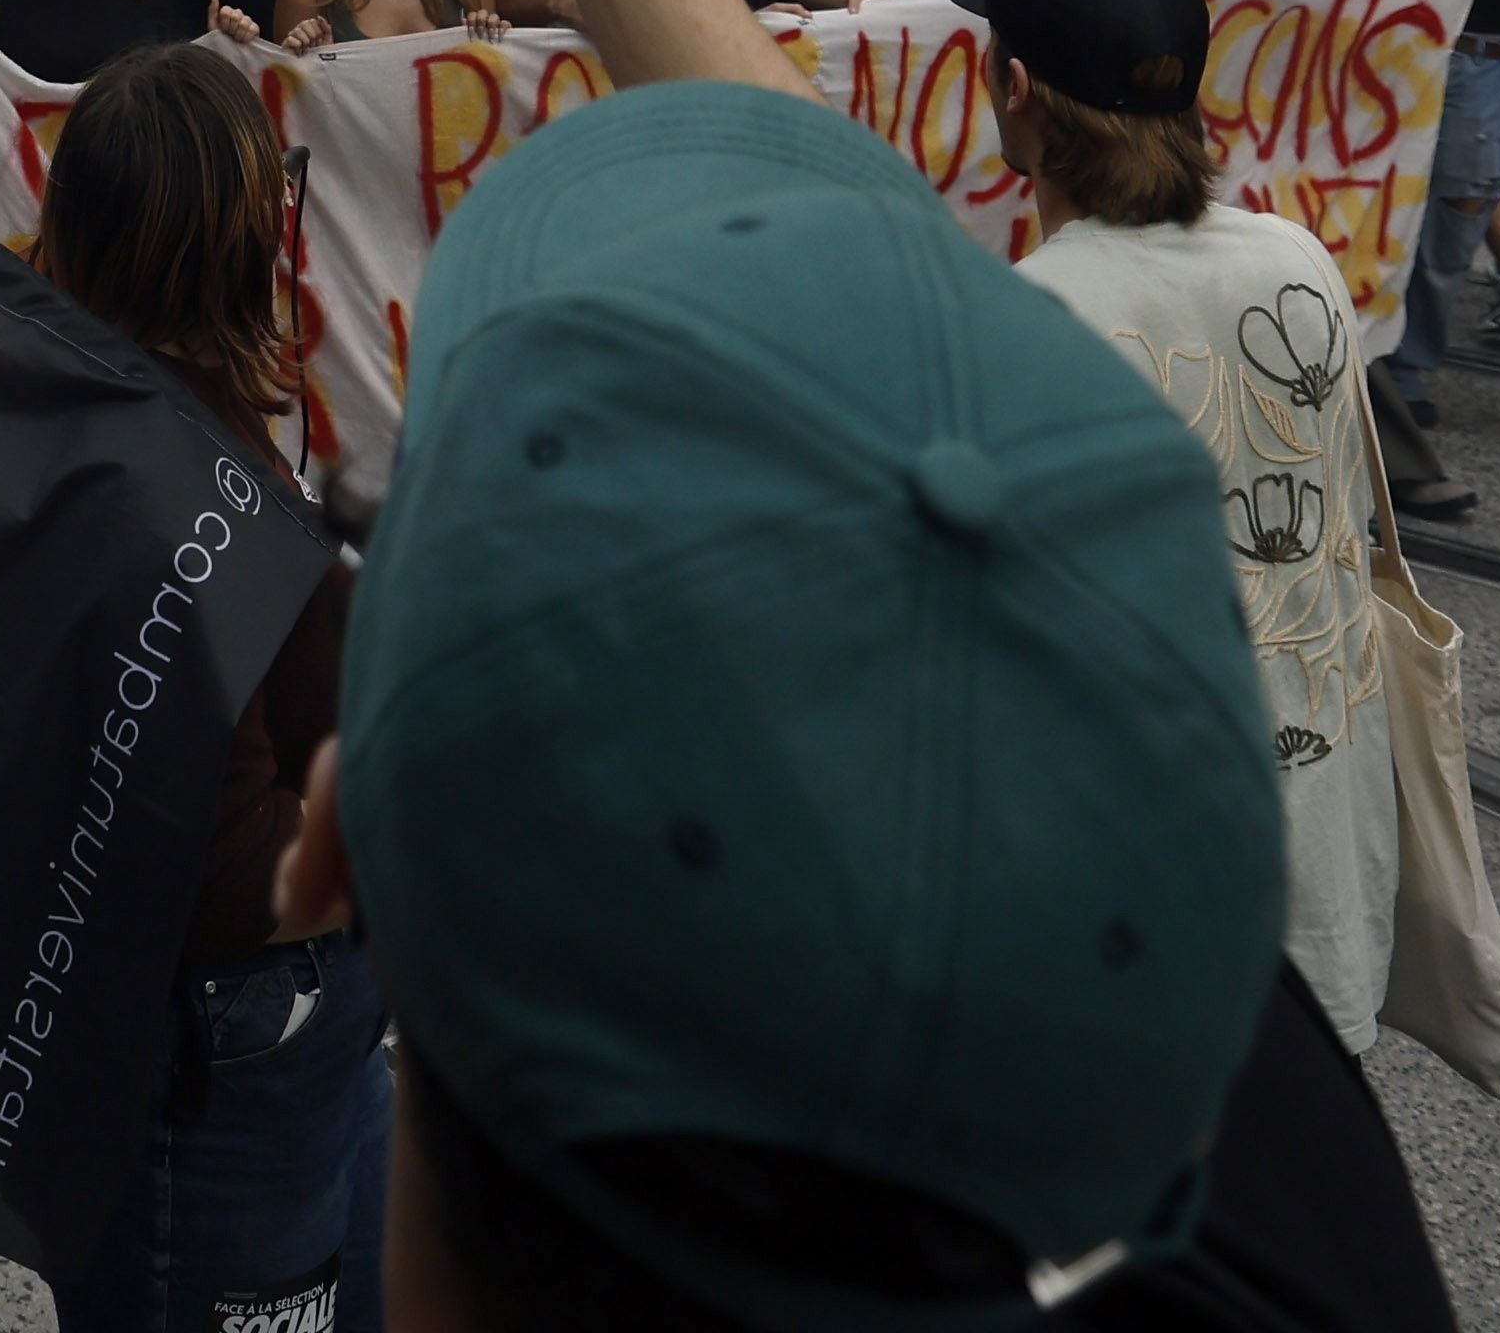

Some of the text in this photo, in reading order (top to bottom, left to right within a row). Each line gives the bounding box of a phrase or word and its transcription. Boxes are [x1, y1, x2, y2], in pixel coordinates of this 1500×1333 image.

[214, 1281, 325, 1315] FACE À LA SÉLECTION
